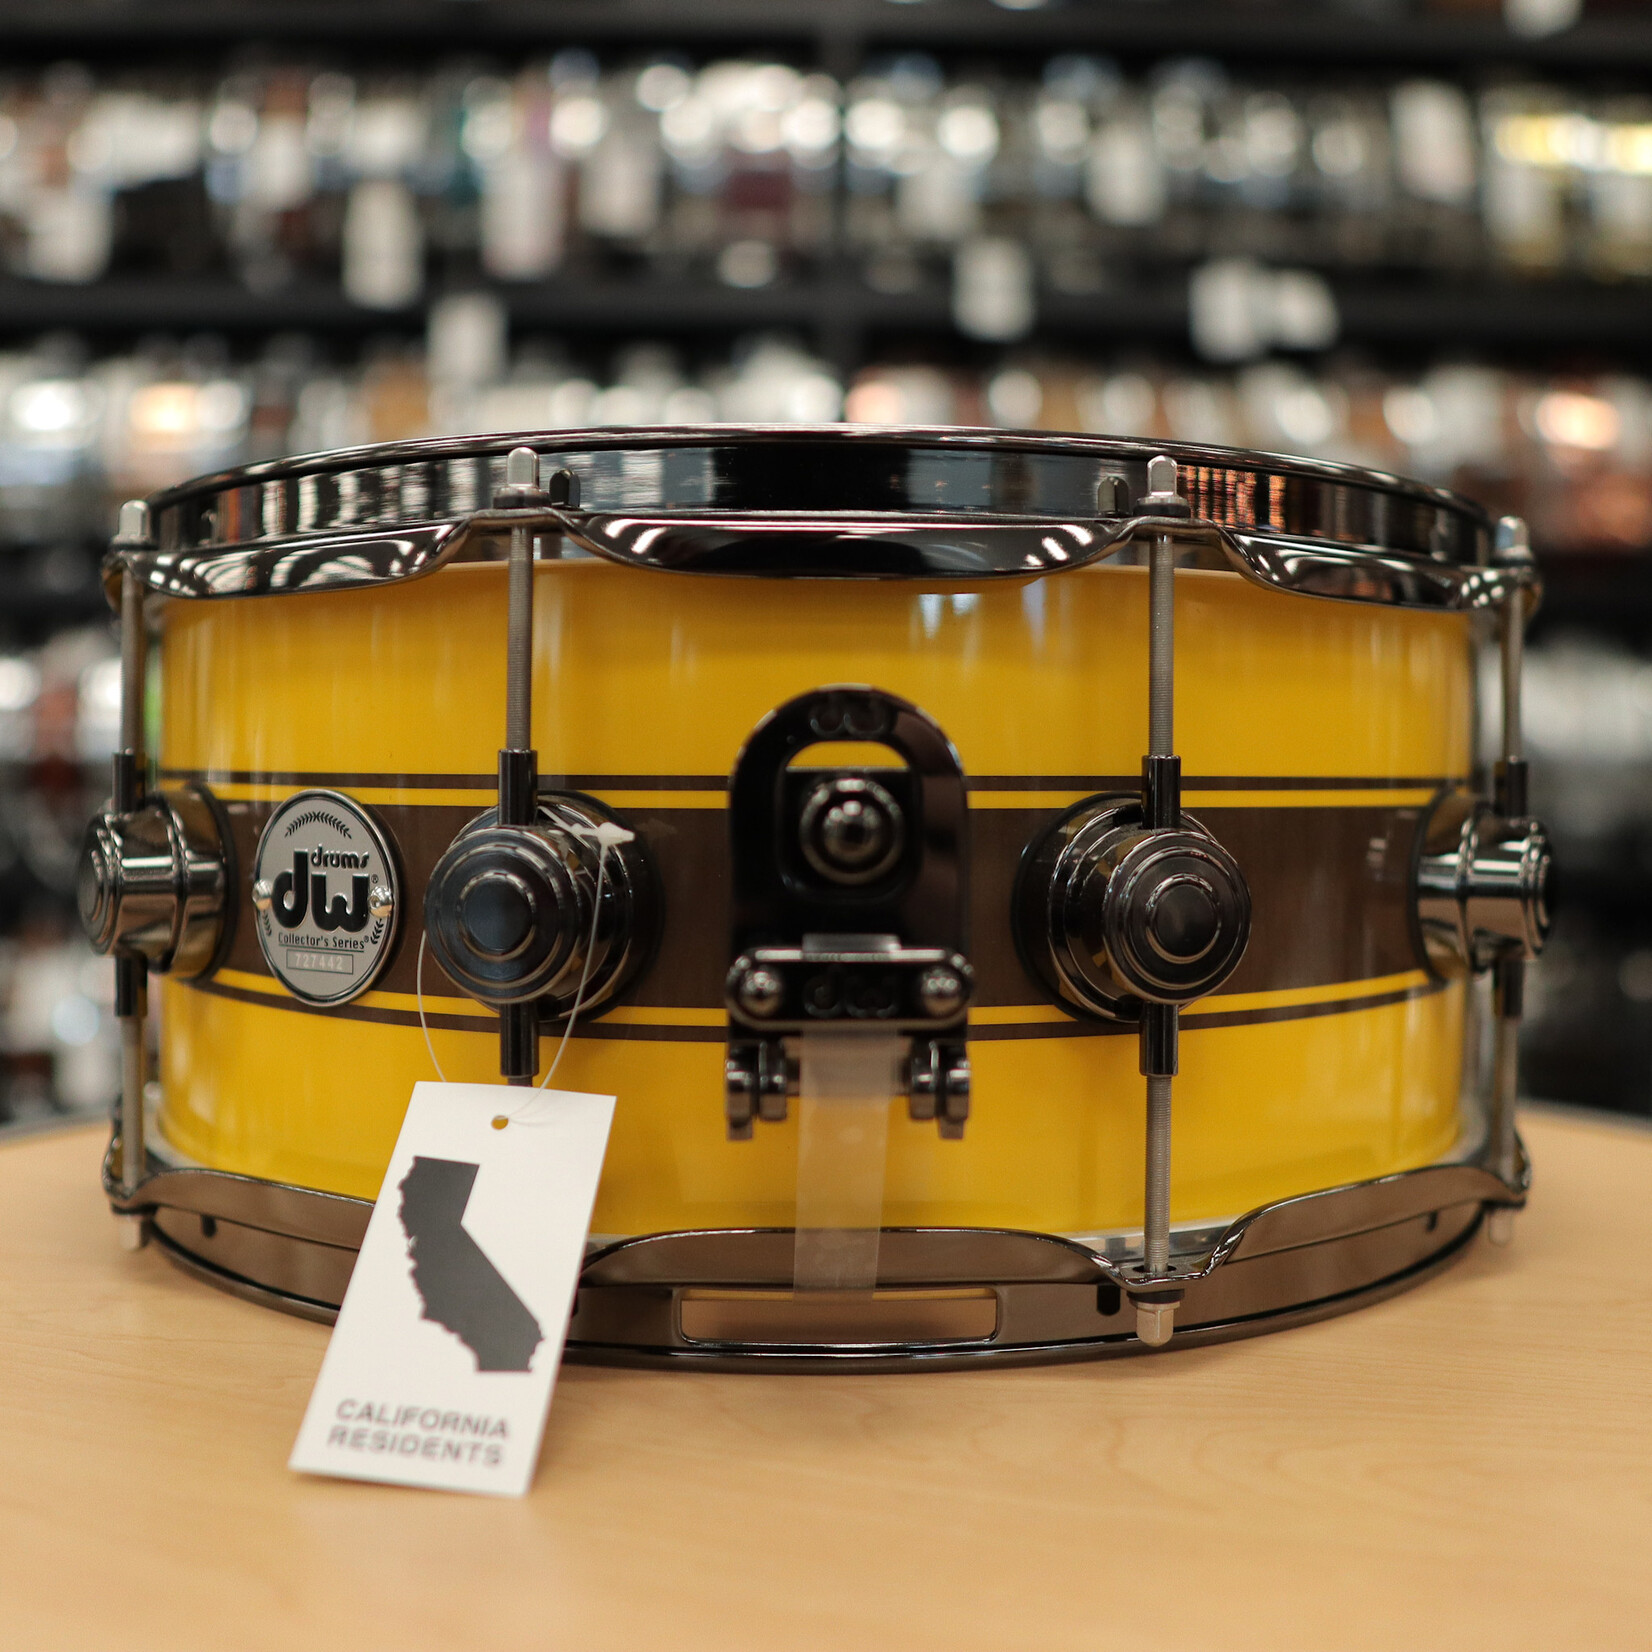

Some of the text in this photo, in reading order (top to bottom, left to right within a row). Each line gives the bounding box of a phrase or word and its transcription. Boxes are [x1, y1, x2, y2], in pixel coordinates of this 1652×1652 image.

[310, 843, 370, 869] drums
[271, 848, 370, 933] dw
[278, 931, 329, 948] Collector's
[294, 953, 344, 970] 727442
[336, 1398, 509, 1438] CALIFORNIA
[327, 1424, 504, 1467] RESIDENTS
